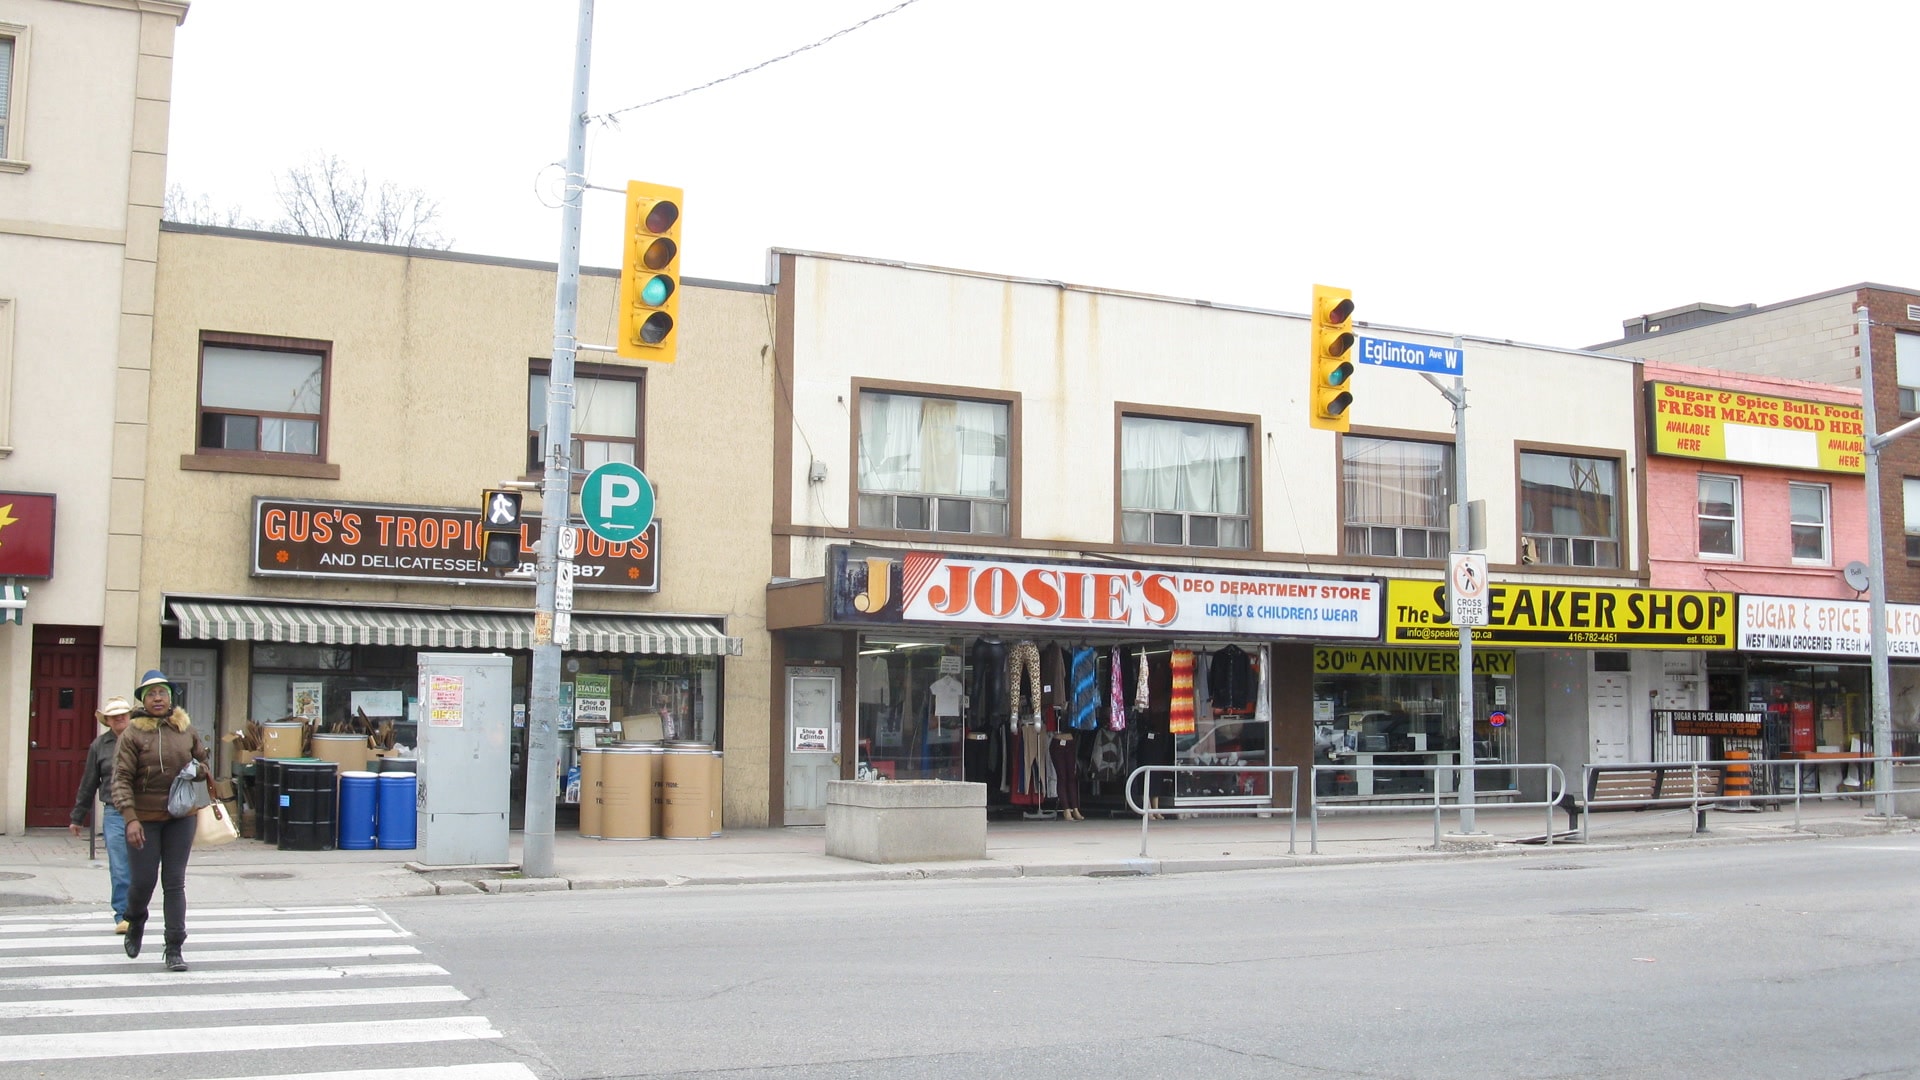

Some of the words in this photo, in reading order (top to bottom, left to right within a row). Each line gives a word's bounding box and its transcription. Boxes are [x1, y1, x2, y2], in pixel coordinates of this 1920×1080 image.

[1365, 339, 1425, 365] Eglinton
[1428, 348, 1442, 360] Ave
[1444, 350, 1458, 369] W
[1664, 385, 1713, 402] Sugar
[1718, 392, 1732, 404] &
[1736, 395, 1778, 410] Spice
[1783, 401, 1820, 415] Bulk
[1657, 399, 1716, 419] FRESH
[1721, 407, 1779, 427] MEATS
[1783, 415, 1825, 431] SOLD
[1829, 421, 1863, 435] HER
[1666, 421, 1710, 436] AVAILABLE
[1677, 438, 1701, 451] HERE
[1828, 439, 1863, 453] AVAILABL
[1838, 455, 1860, 467] HERE
[600, 474, 640, 518] P
[264, 509, 362, 545] GUS'S
[320, 553, 356, 566] AND
[854, 557, 893, 614] J
[1183, 579, 1215, 593] DEO
[1219, 580, 1318, 598] DEPARTMENT
[1321, 586, 1371, 600] STORE
[927, 564, 1181, 626] JOSIE'S
[1457, 598, 1482, 606] CROSS
[1205, 603, 1243, 618] LADIES
[1246, 605, 1254, 618] &
[1257, 605, 1319, 621] CHILDRENS
[1321, 609, 1358, 622] WEAR
[1397, 606, 1429, 623] The
[1432, 585, 1616, 629] SEAKER
[1627, 593, 1726, 630] SHOP
[1457, 607, 1483, 616] OTHER
[1462, 616, 1479, 624] SIDE
[1746, 601, 1796, 630] SUGAR
[1818, 607, 1861, 634] SPICE
[1406, 628, 1492, 640] info@speakeop.ca
[1568, 632, 1618, 643] 416-782-4451
[1687, 635, 1699, 644] est.
[1701, 635, 1717, 644] 1983
[1746, 634, 1766, 648] WEST
[1767, 634, 1791, 649] INDIAN
[1793, 636, 1832, 650] GROCERIES
[1836, 638, 1861, 651] FRESH
[1316, 650, 1357, 670] 30th
[1360, 651, 1511, 672] ANNIVERARY
[577, 685, 607, 693] STATION
[1673, 712, 1691, 721] SUGAR
[1692, 712, 1697, 721] &
[1698, 712, 1714, 721] SPICE
[1715, 713, 1729, 722] BULK
[1729, 713, 1744, 722] FOOD
[1745, 713, 1762, 723] MART
